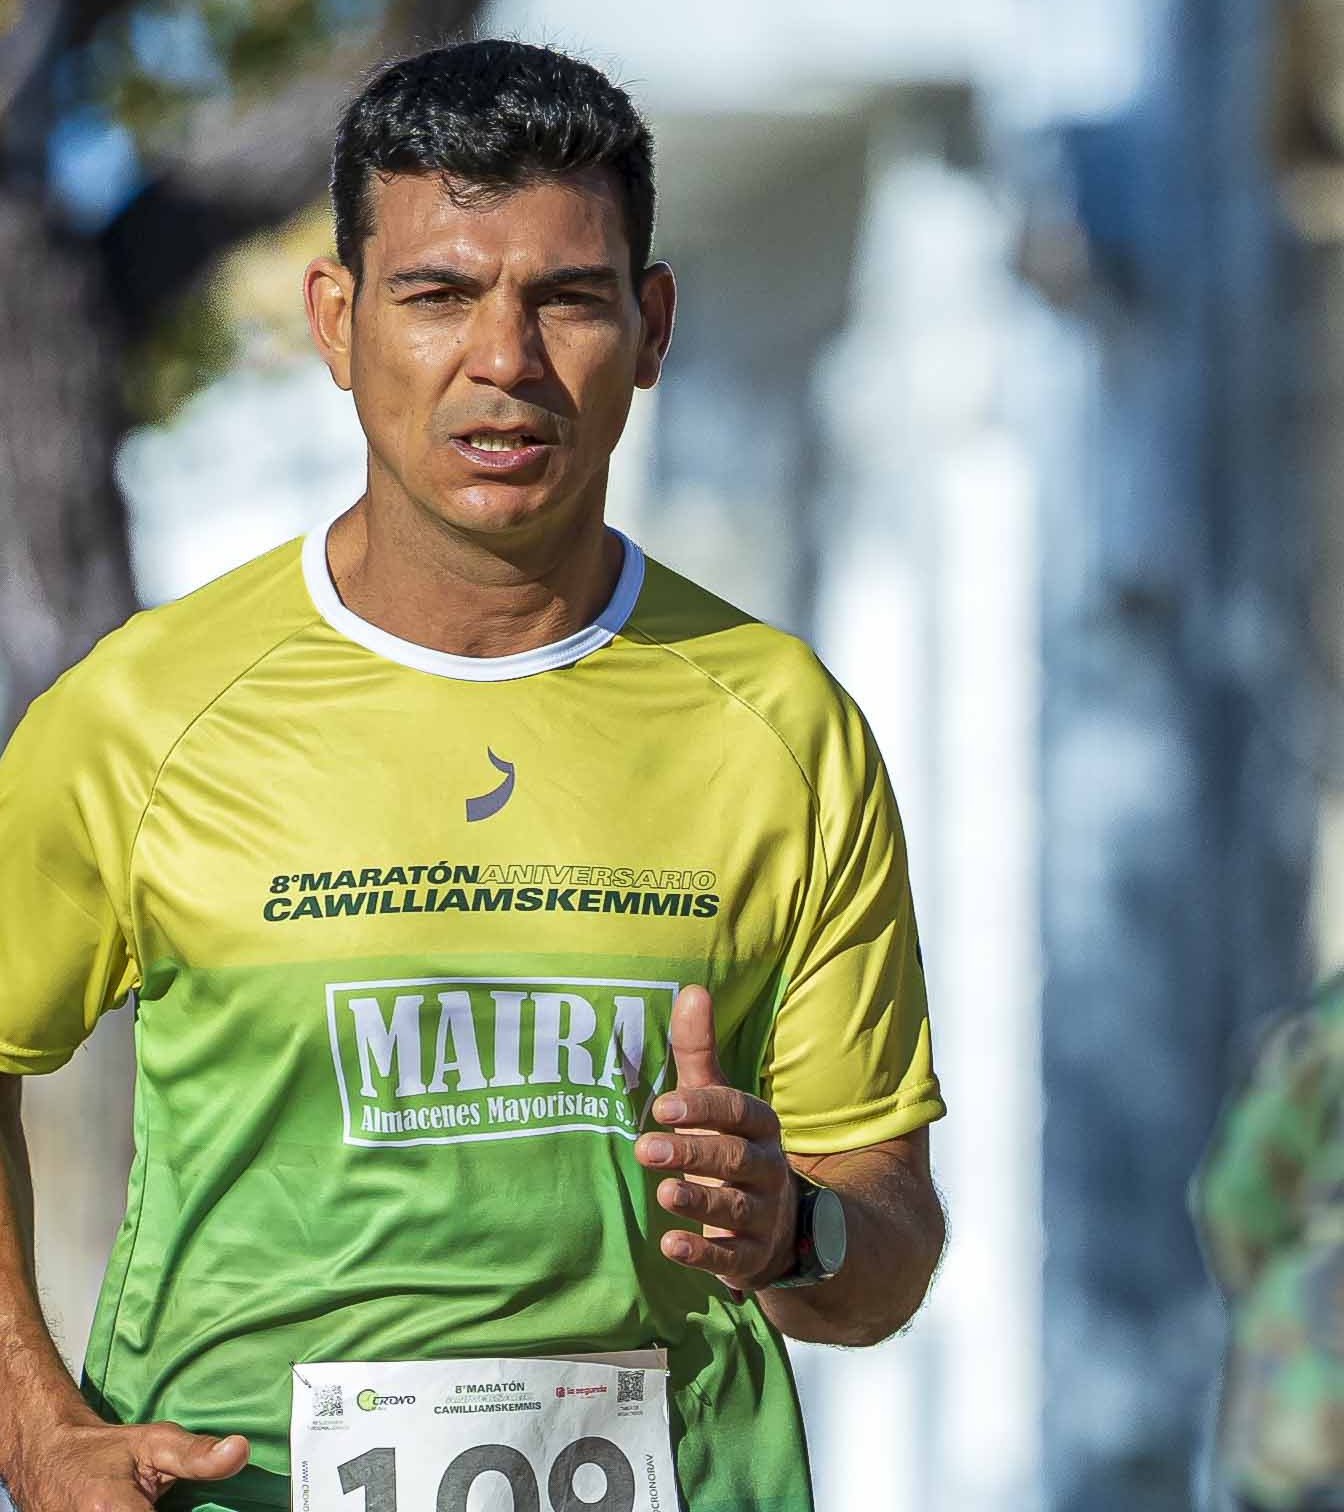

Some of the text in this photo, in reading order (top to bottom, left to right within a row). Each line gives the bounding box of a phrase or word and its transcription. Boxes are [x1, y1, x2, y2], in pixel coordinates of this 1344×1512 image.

[478, 864, 717, 890] ANIVERSARIO
[348, 990, 645, 1098] MAIRA
[361, 1102, 481, 1134] Almacenes
[487, 1091, 609, 1124] Mayoristas
